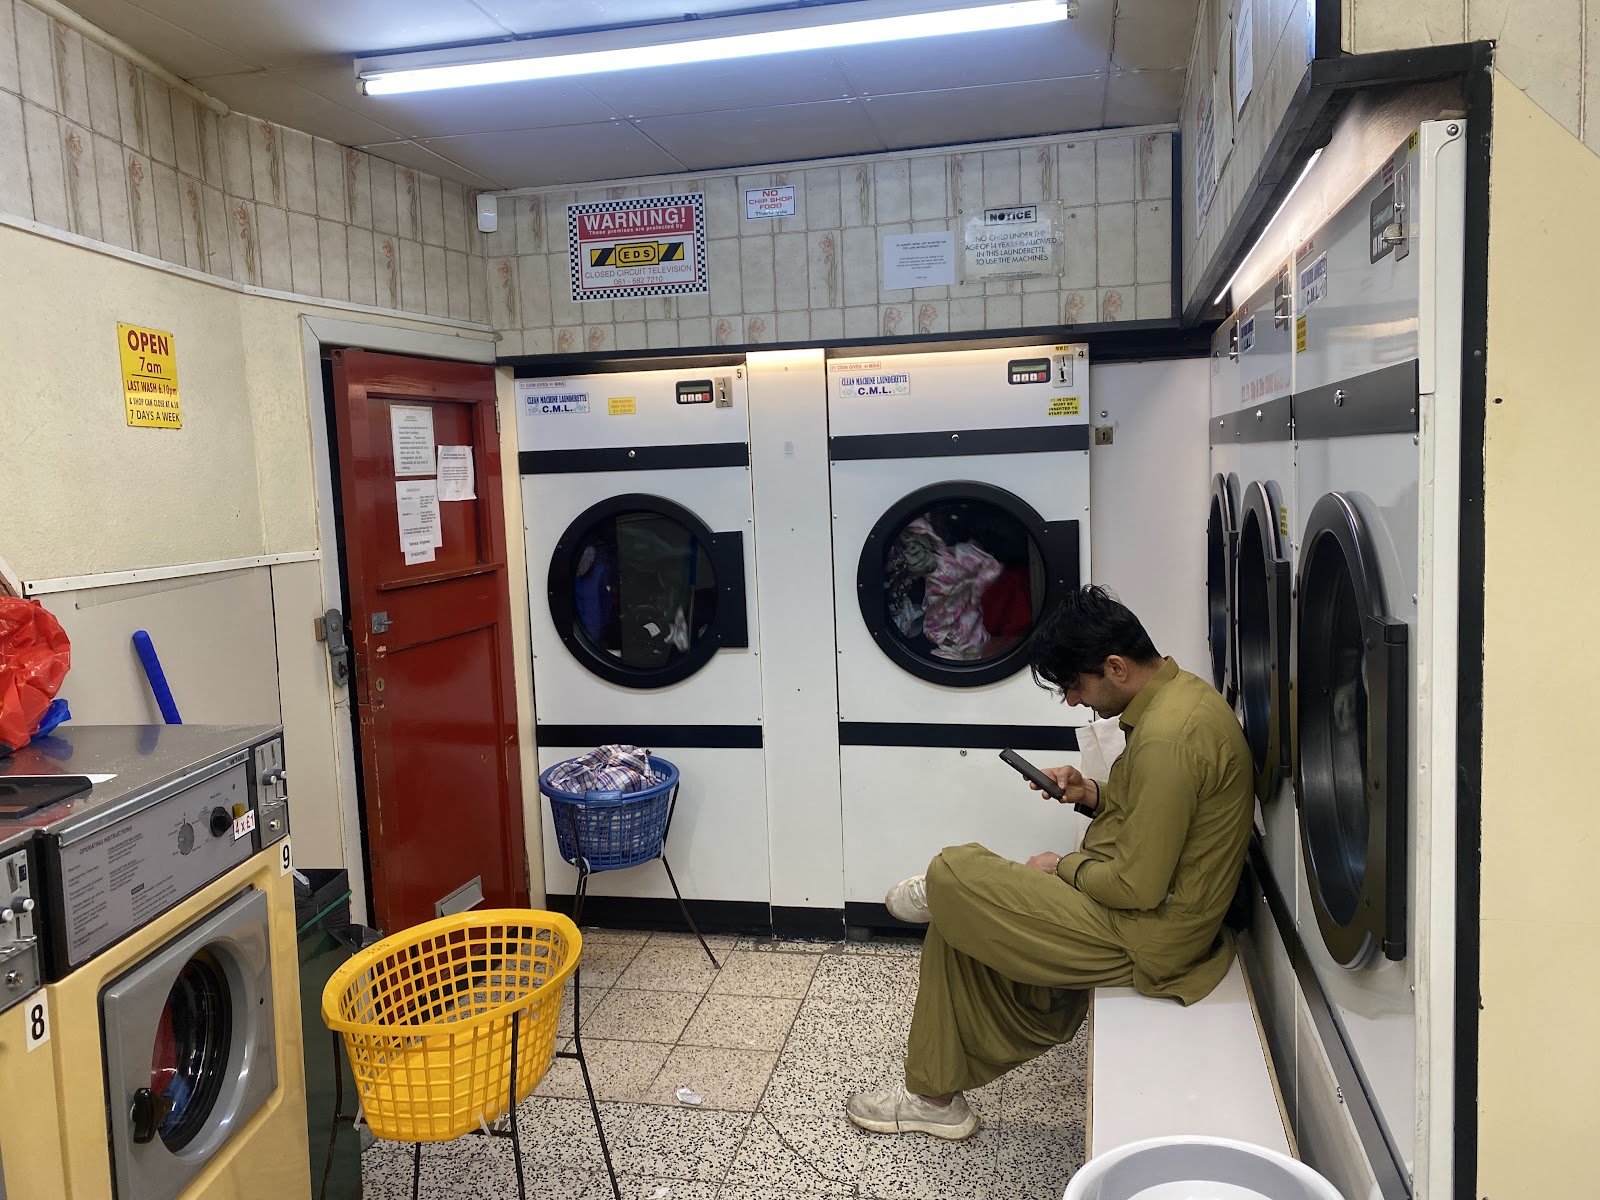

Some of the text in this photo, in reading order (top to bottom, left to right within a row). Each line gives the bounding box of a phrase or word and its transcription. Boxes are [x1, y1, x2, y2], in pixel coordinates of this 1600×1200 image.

[584, 207, 686, 230] WARNING!
[990, 210, 1031, 221] NOTICE
[1010, 231, 1033, 239] UNDER
[624, 250, 650, 259] EDS
[1000, 246, 1045, 255] LAUNDERETTE
[1012, 254, 1048, 262] MACHINES
[585, 265, 692, 279] CLOSED CIRCUIT TELEVISION
[128, 330, 168, 356] OPEN
[139, 357, 162, 374] 7am
[736, 369, 742, 379] 5
[856, 377, 875, 385] MACHINE
[876, 375, 907, 384] LAUNDERETTE
[127, 380, 177, 397] LAST WASH 6.10pm
[858, 386, 891, 395] C.M.L.
[540, 396, 558, 404] MACHINE
[559, 394, 587, 403] LAUNDERETTE
[130, 410, 180, 422] 7 DAYS A WEEK
[230, 754, 244, 764] W100
[235, 820, 240, 834] 4
[247, 814, 254, 828] £1
[79, 839, 103, 854] OPERATING
[104, 826, 132, 843] INSTRUCTIONS
[283, 845, 289, 869] 9
[31, 1004, 44, 1040] 8
